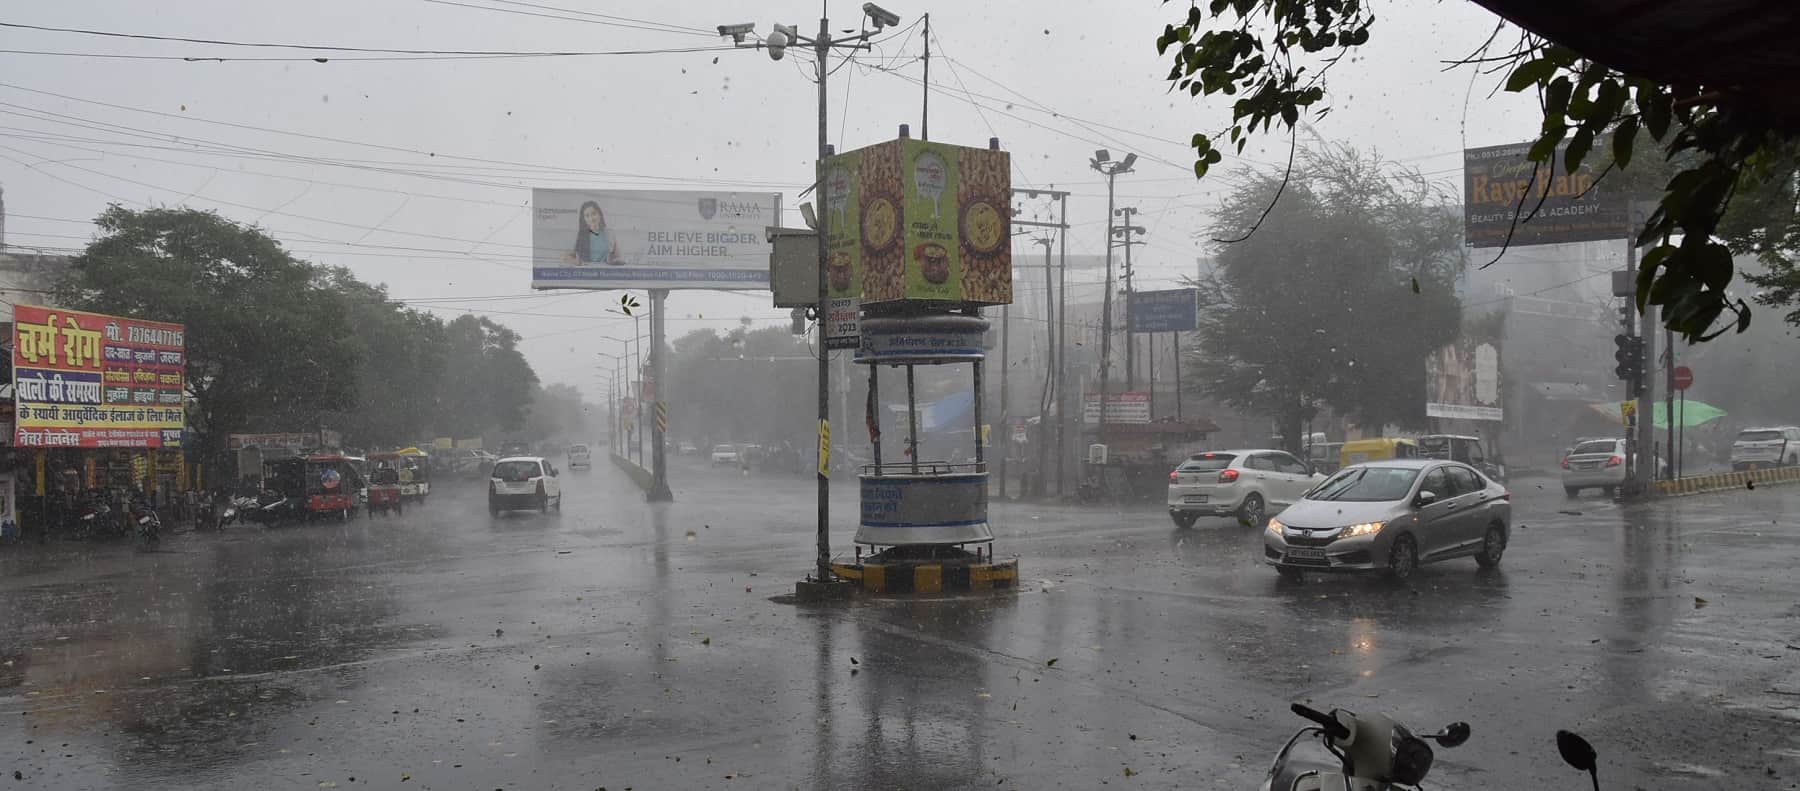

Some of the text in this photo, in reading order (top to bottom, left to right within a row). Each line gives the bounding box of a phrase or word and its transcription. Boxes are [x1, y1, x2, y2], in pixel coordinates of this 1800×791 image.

[720, 201, 760, 213] RAMA
[1539, 208, 1547, 218] &
[1549, 203, 1600, 217] ACADEMY
[648, 231, 704, 243] BELIEVE
[647, 244, 673, 256] AIM
[16, 313, 102, 368] चर्म रोग
[105, 321, 183, 347] मो. 7376447715
[48, 373, 64, 402] की
[65, 380, 101, 403] समस्या
[19, 404, 31, 419] के
[19, 428, 42, 446] नेचर
